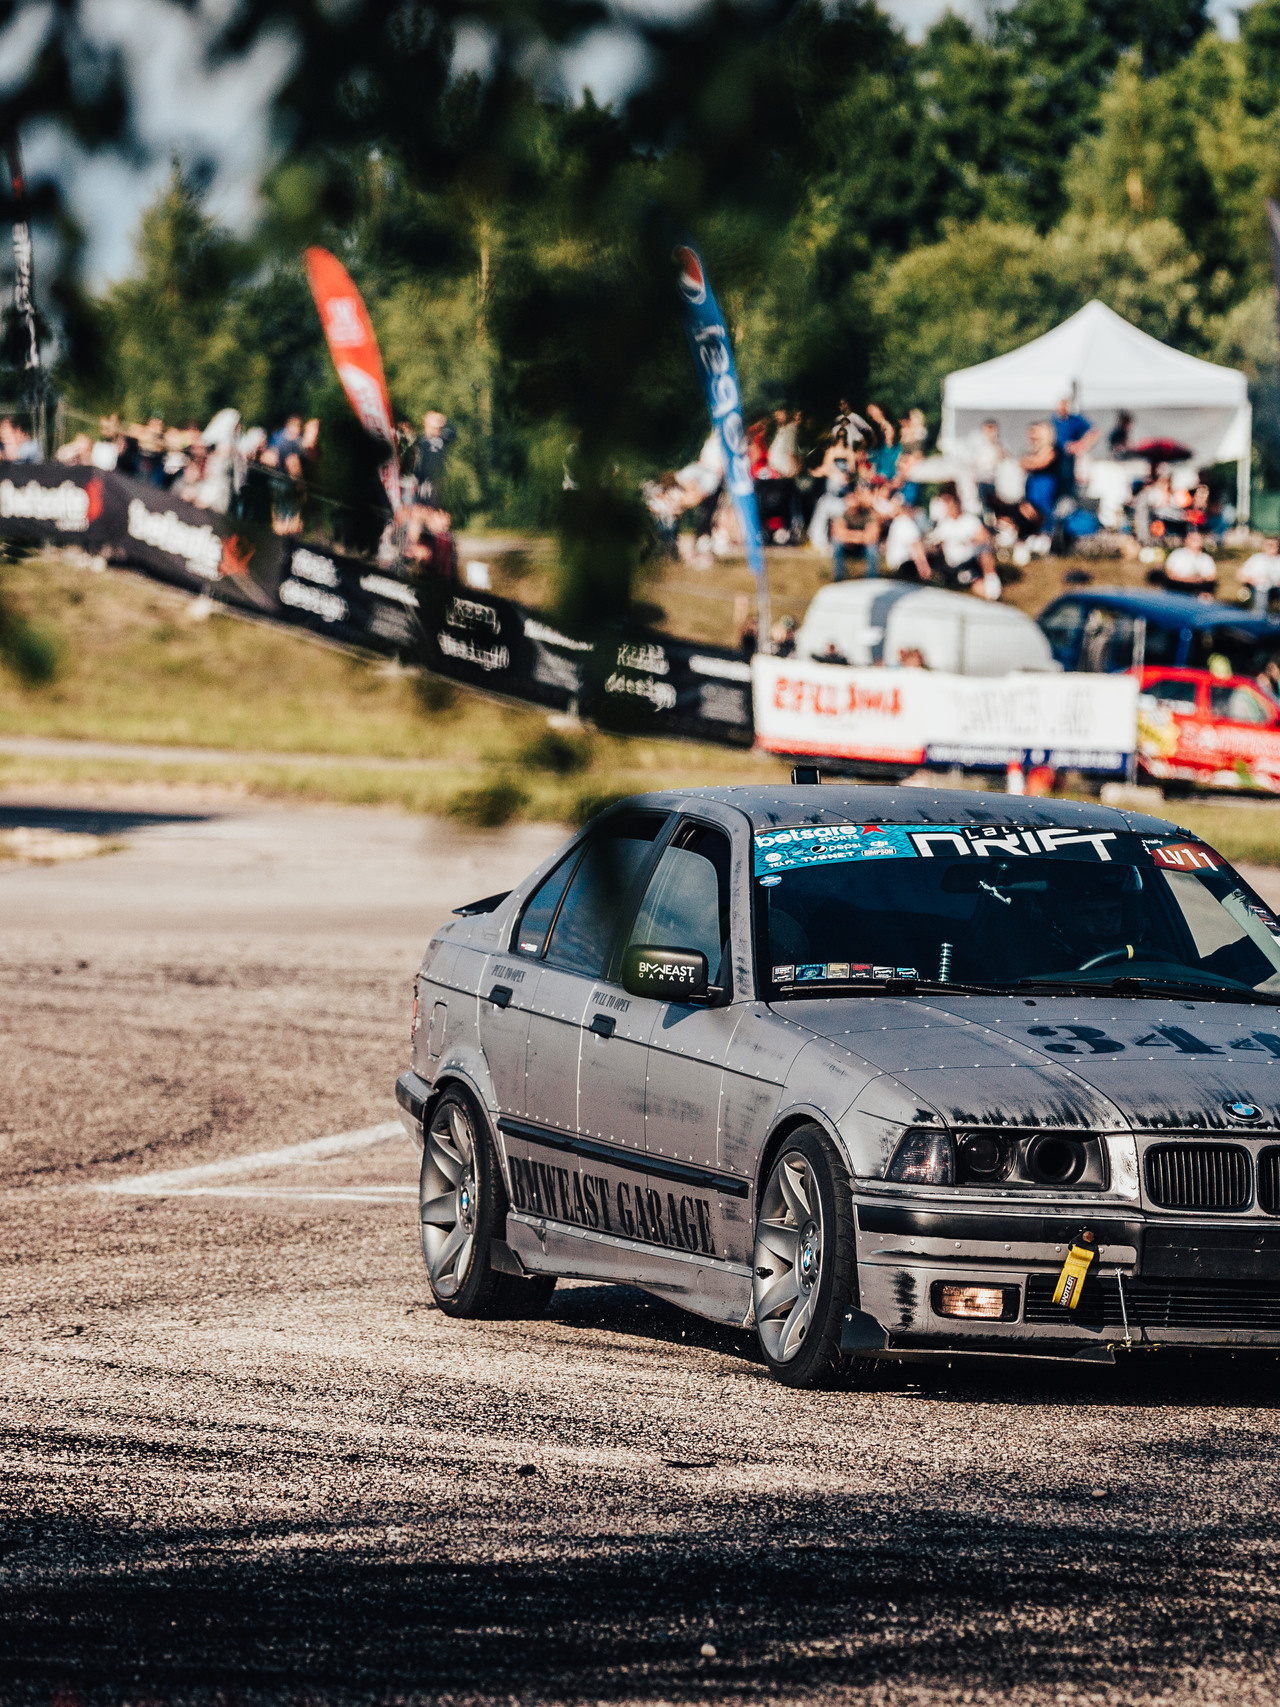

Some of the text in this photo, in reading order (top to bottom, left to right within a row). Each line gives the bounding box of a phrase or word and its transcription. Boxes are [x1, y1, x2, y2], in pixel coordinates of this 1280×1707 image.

[818, 834, 860, 843] SPORTS
[828, 842, 862, 851] pepsi
[638, 972, 695, 984] GARAGE
[508, 1155, 717, 1256] BMWEAST GARAGE
